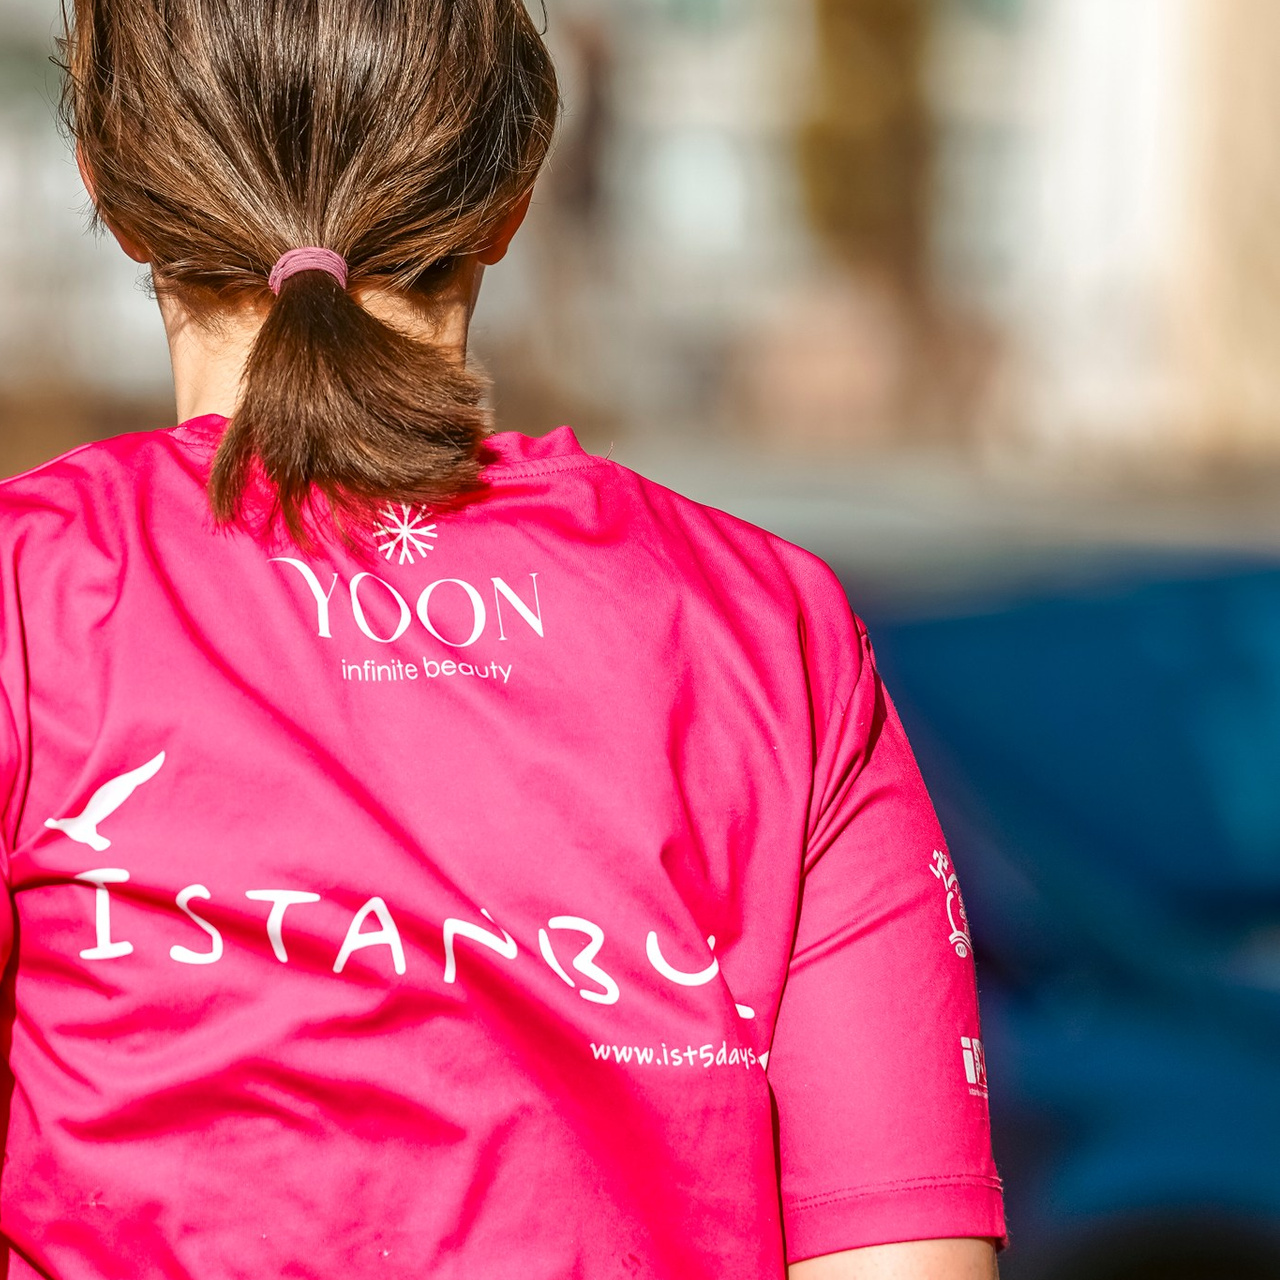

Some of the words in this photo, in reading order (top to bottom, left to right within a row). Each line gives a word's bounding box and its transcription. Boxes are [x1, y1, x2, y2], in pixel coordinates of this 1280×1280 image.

[267, 557, 545, 648] YOON
[341, 658, 418, 681] infinite
[422, 656, 513, 684] beauty
[74, 867, 756, 1019] ISTANBU
[589, 1040, 762, 1070] www.ist5days.
